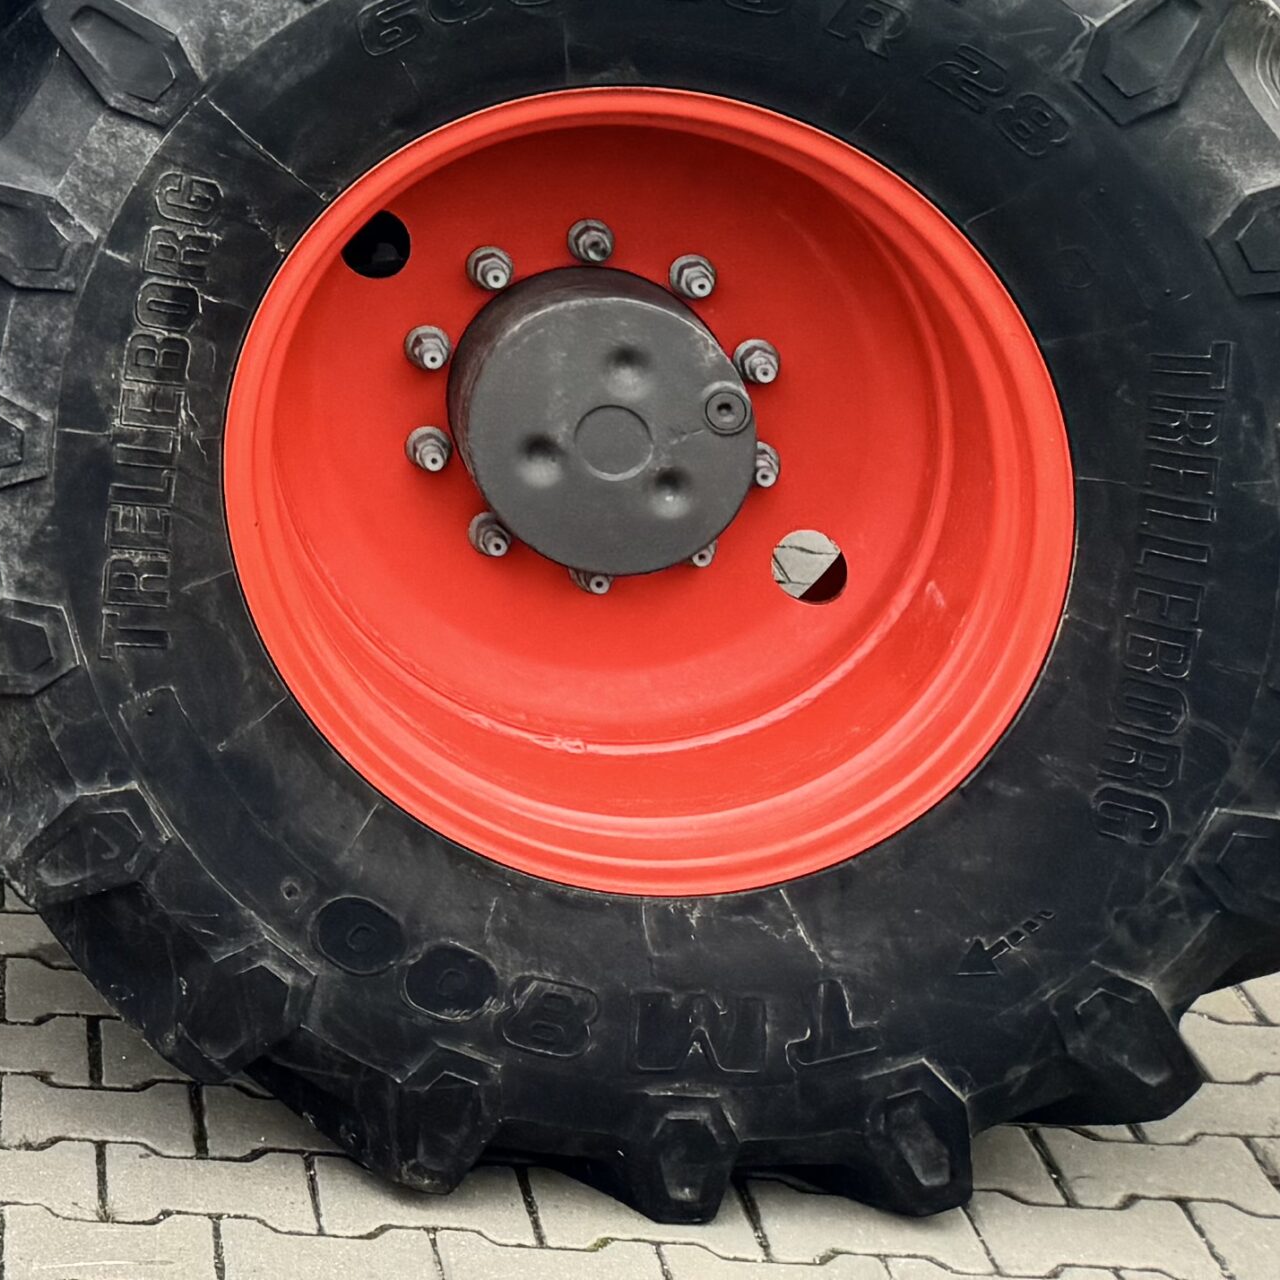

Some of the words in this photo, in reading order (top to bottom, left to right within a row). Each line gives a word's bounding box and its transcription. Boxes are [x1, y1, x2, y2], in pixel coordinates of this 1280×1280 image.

[926, 43, 1072, 157] 28
[99, 169, 225, 661] TRELLEBORG
[1092, 338, 1238, 849] TRELLEBORG
